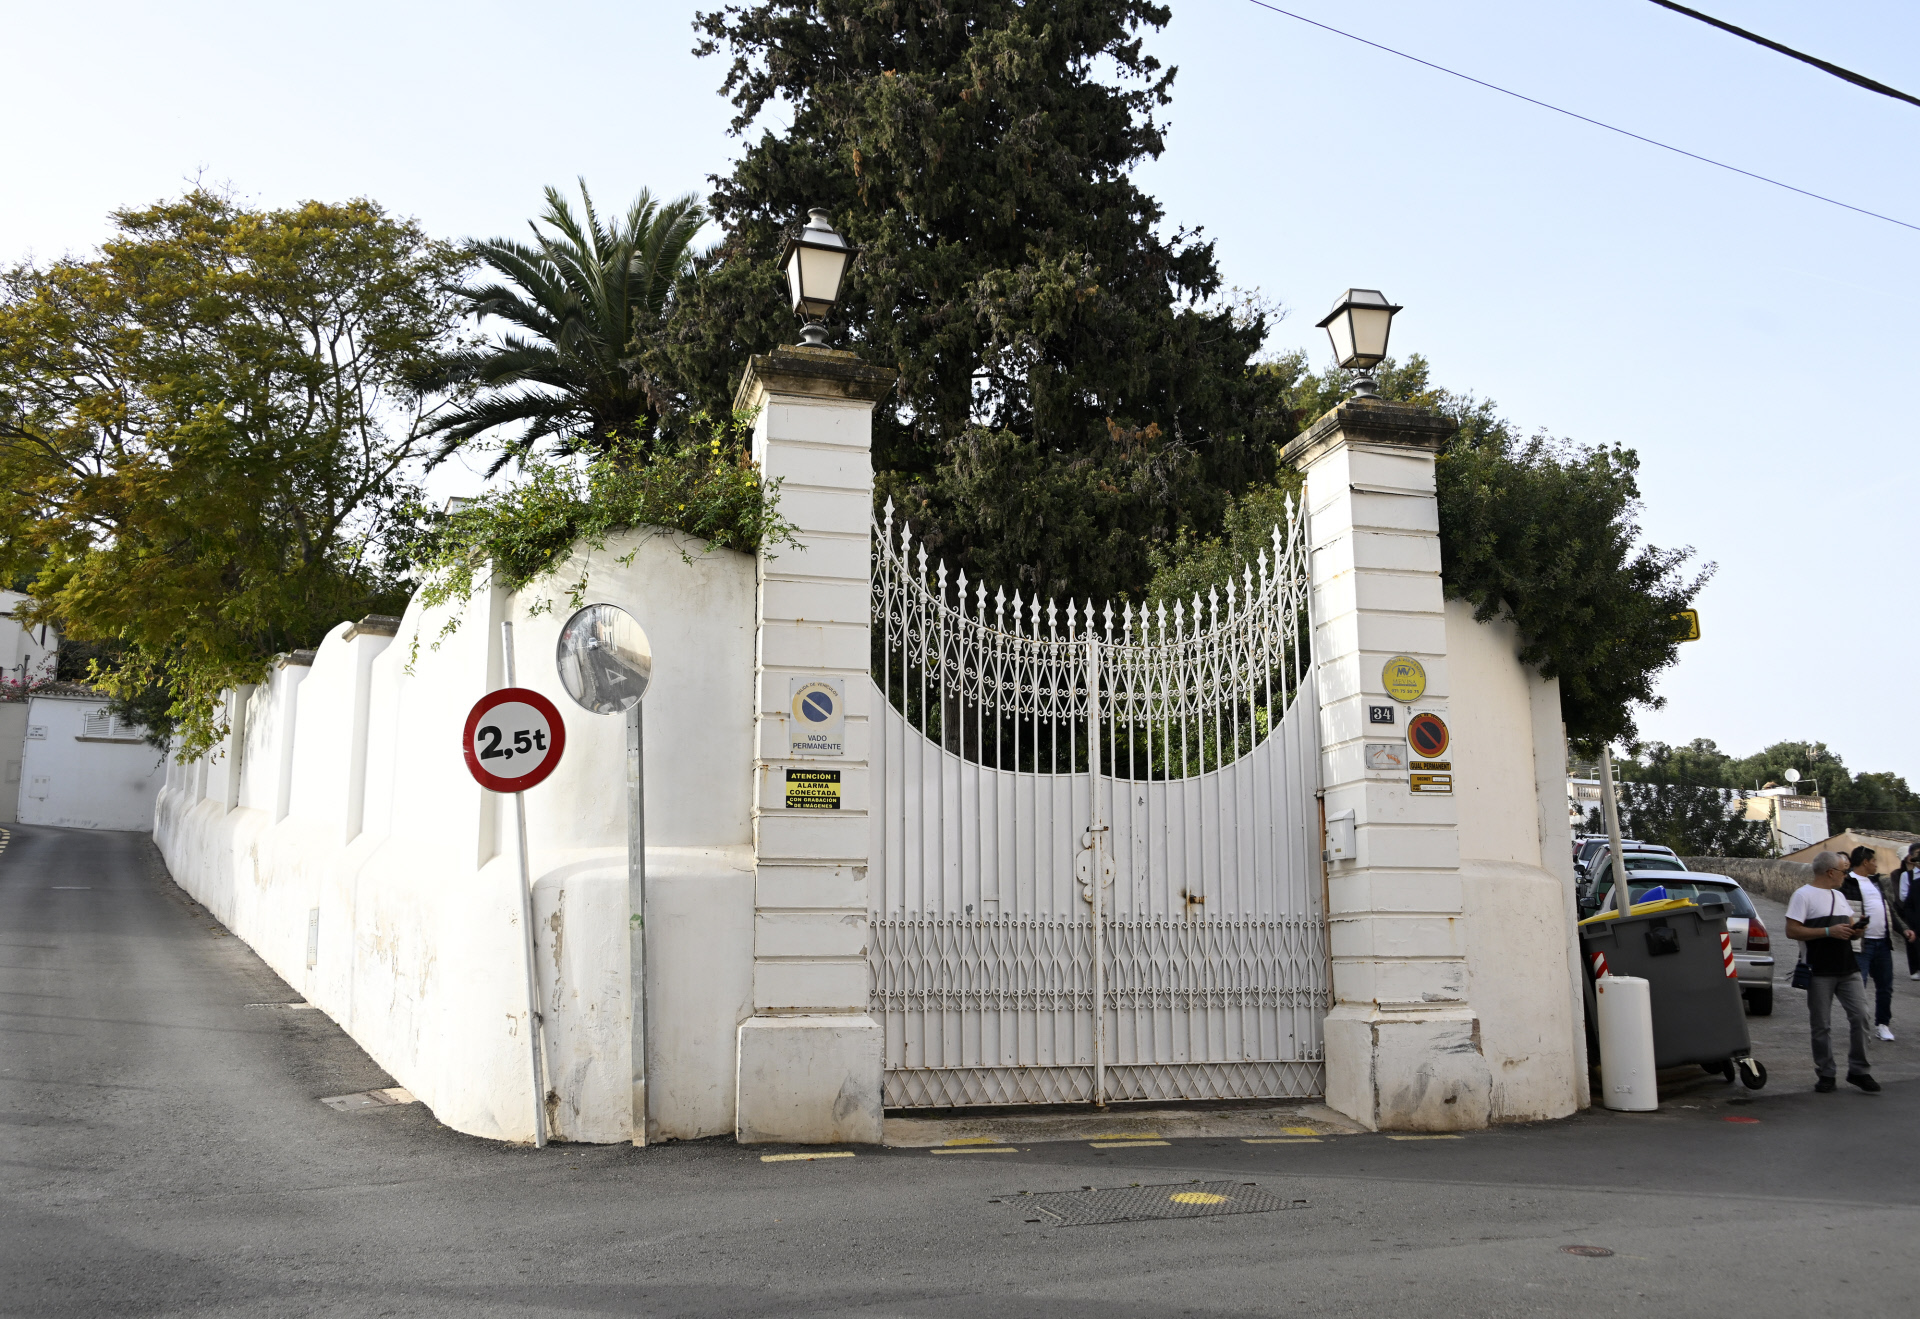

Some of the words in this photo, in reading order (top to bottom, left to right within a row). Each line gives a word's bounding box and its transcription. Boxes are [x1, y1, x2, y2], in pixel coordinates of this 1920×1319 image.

[796, 684, 809, 695] SALIDA
[1374, 708, 1391, 720] 34
[477, 725, 547, 760] 2,5t
[792, 742, 842, 750] PERMANENTE
[1423, 762, 1450, 770] PERMANENT
[791, 772, 831, 780] ATENCIÓN
